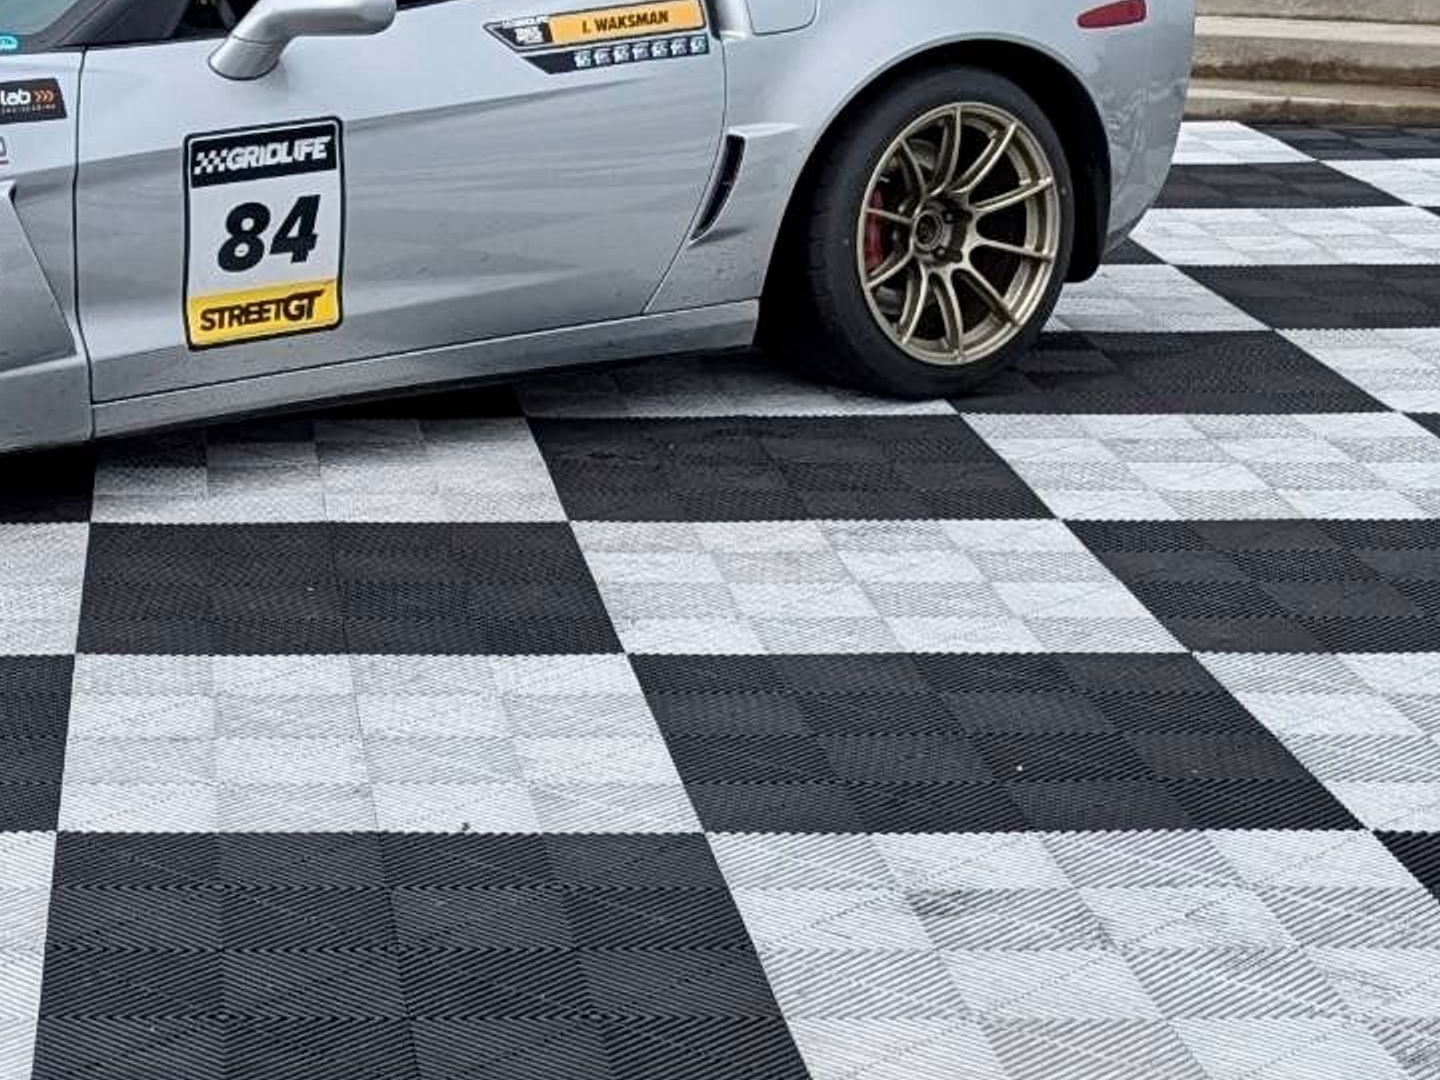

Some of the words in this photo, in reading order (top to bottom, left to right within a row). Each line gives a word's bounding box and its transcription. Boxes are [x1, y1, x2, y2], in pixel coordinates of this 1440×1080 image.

[595, 11, 669, 32] WAKSMAN
[0, 88, 31, 106] lab
[226, 135, 331, 171] GRIDLIFE
[218, 195, 321, 272] 84
